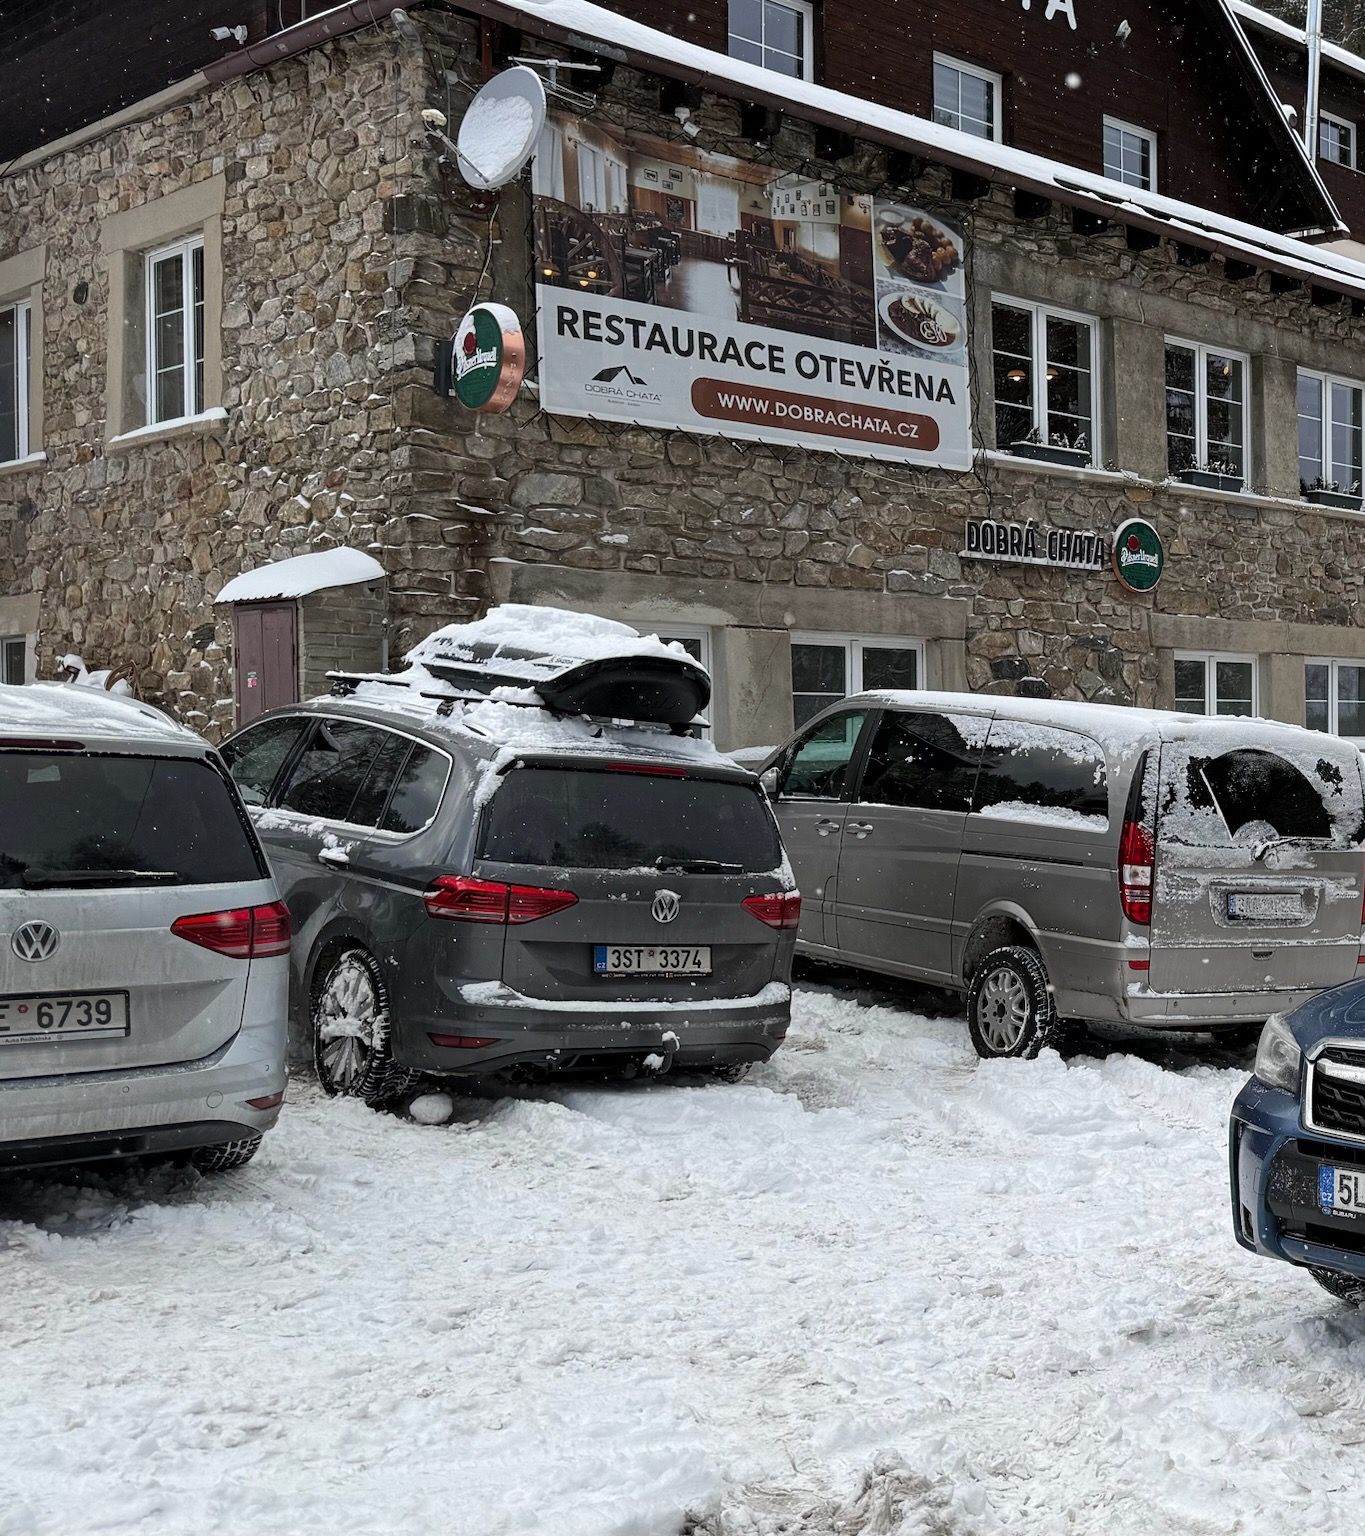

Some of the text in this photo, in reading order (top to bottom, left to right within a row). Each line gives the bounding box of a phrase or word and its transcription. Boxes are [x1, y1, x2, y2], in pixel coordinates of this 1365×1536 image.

[557, 305, 956, 405] RESTAURACE OTEVŘENA
[717, 391, 919, 439] WWW.DOBRACHATA.CZ
[965, 518, 1105, 566] DOBRÁ CHATA
[611, 949, 702, 969] 3ST 3374
[36, 998, 112, 1029] 6739
[1332, 1209, 1357, 1219] SUBARU
